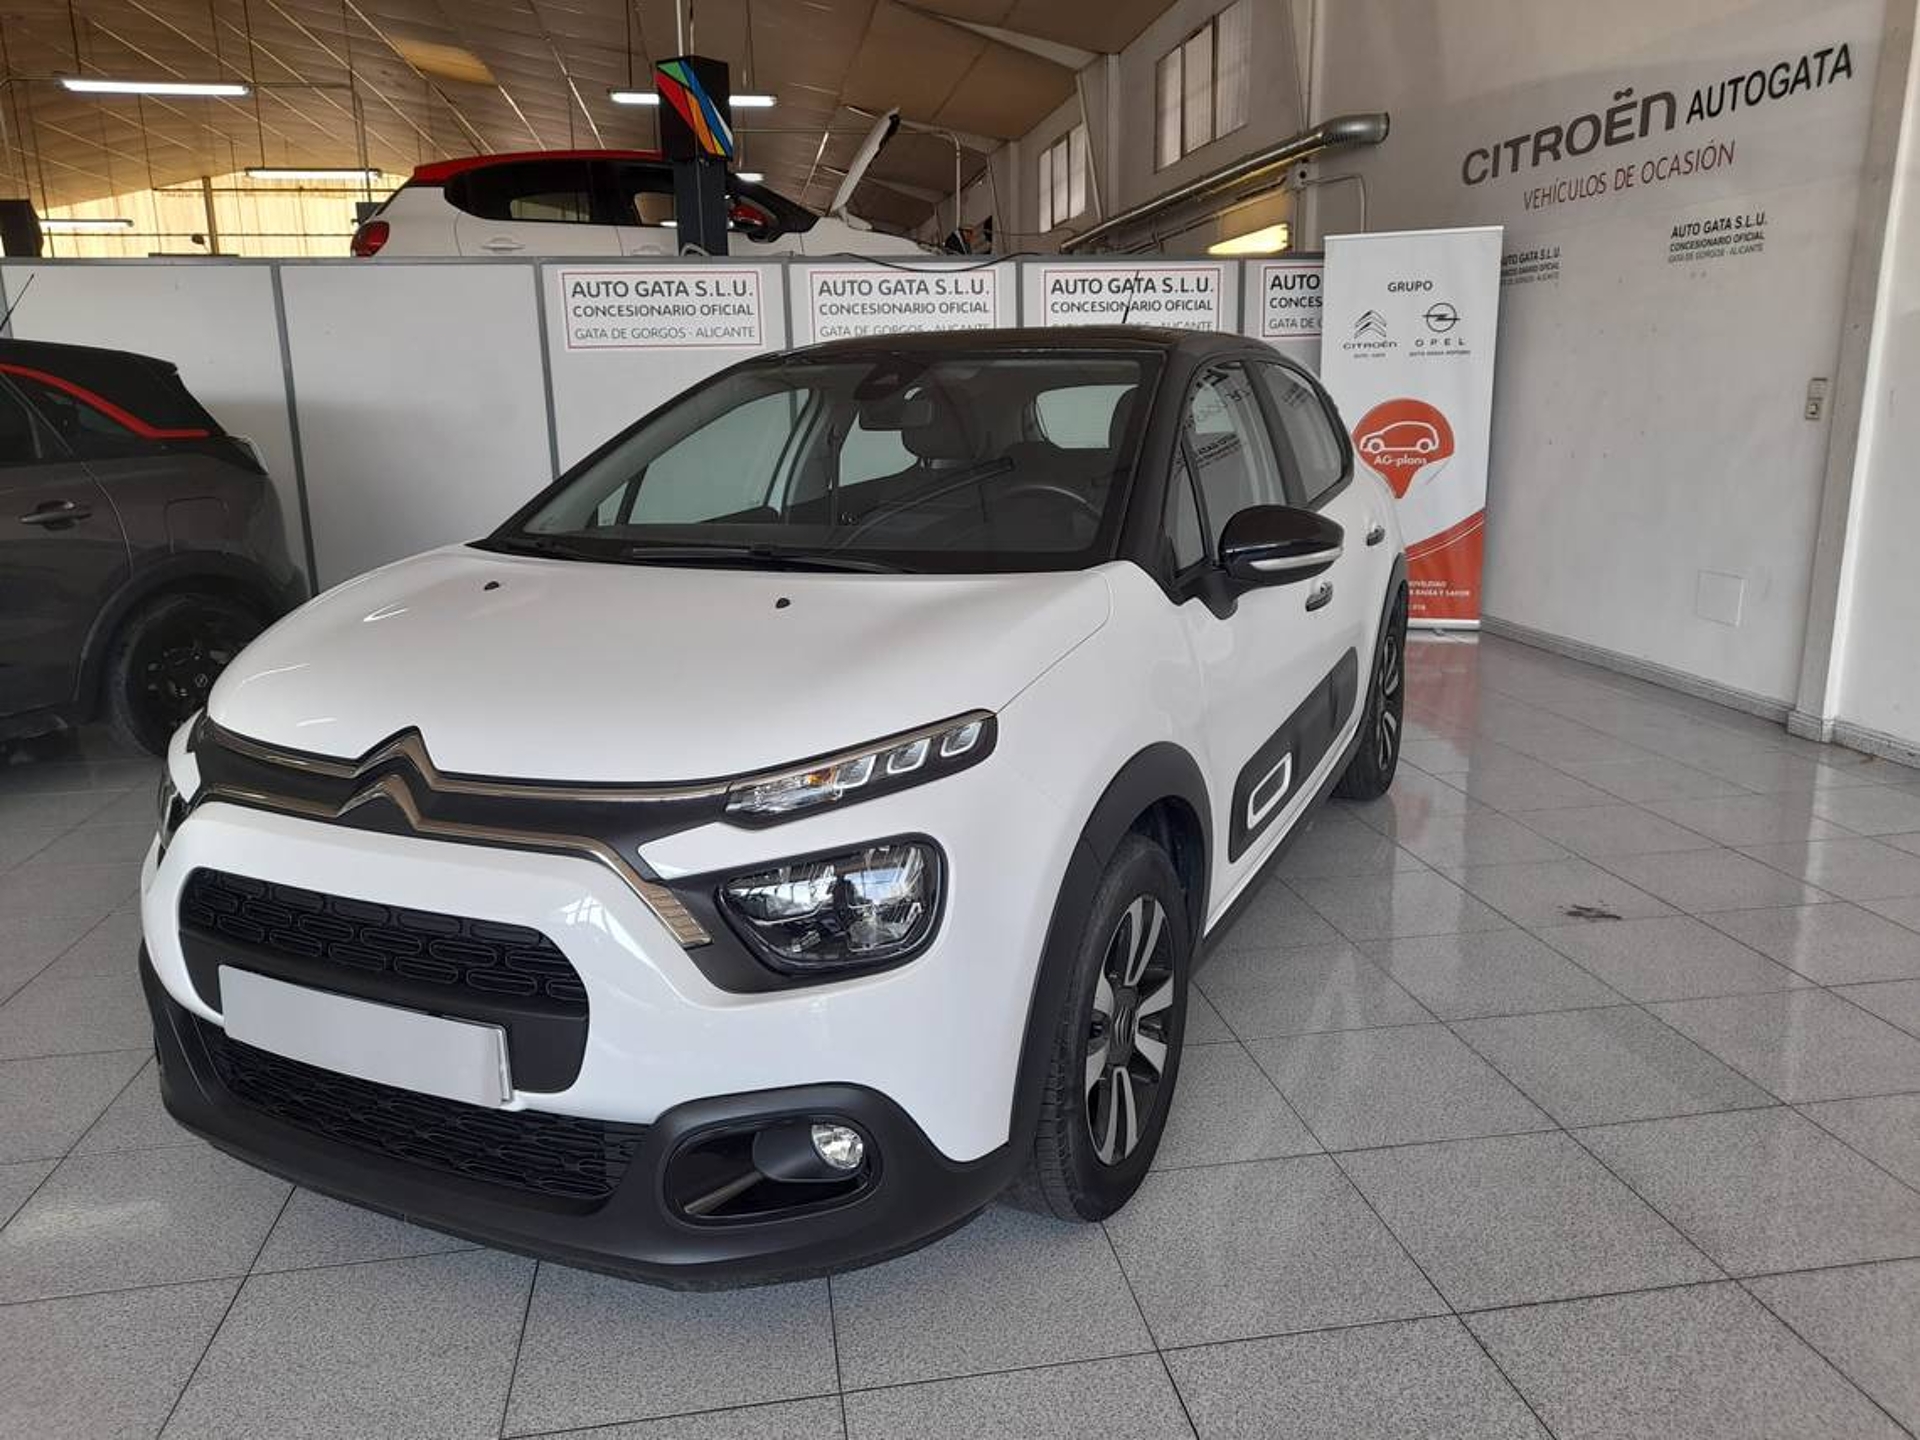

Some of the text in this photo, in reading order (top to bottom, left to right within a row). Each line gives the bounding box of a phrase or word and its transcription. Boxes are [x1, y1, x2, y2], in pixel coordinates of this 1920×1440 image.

[1686, 42, 1852, 124] AUTOGATA
[1523, 139, 1736, 211] VEHÍCULOS DE OCASIÓN
[1670, 222, 1701, 239] AUTO
[1703, 217, 1732, 234] GATA
[571, 279, 754, 298] AUTO GATA S.L.U.
[818, 278, 990, 297] AUTO GATA S.L.U.
[1051, 277, 1213, 294] AUTO GATA S.L.U.
[1270, 274, 1320, 290] AUTO
[1387, 280, 1433, 292] GRUPO
[573, 304, 754, 317] CONCESIONARIO OFICIAL
[819, 302, 990, 316] CONCESIONARIO OFICIAL
[1051, 300, 1213, 313] CONCESIONARIO OFICIAL
[1269, 318, 1297, 329] GATA
[1300, 317, 1314, 329] DE
[575, 328, 608, 339] GATA
[611, 328, 627, 339] DE
[631, 327, 686, 339] GORGOS
[695, 327, 755, 338] ALICANTE
[820, 326, 850, 338] GATA
[854, 325, 869, 337] DE
